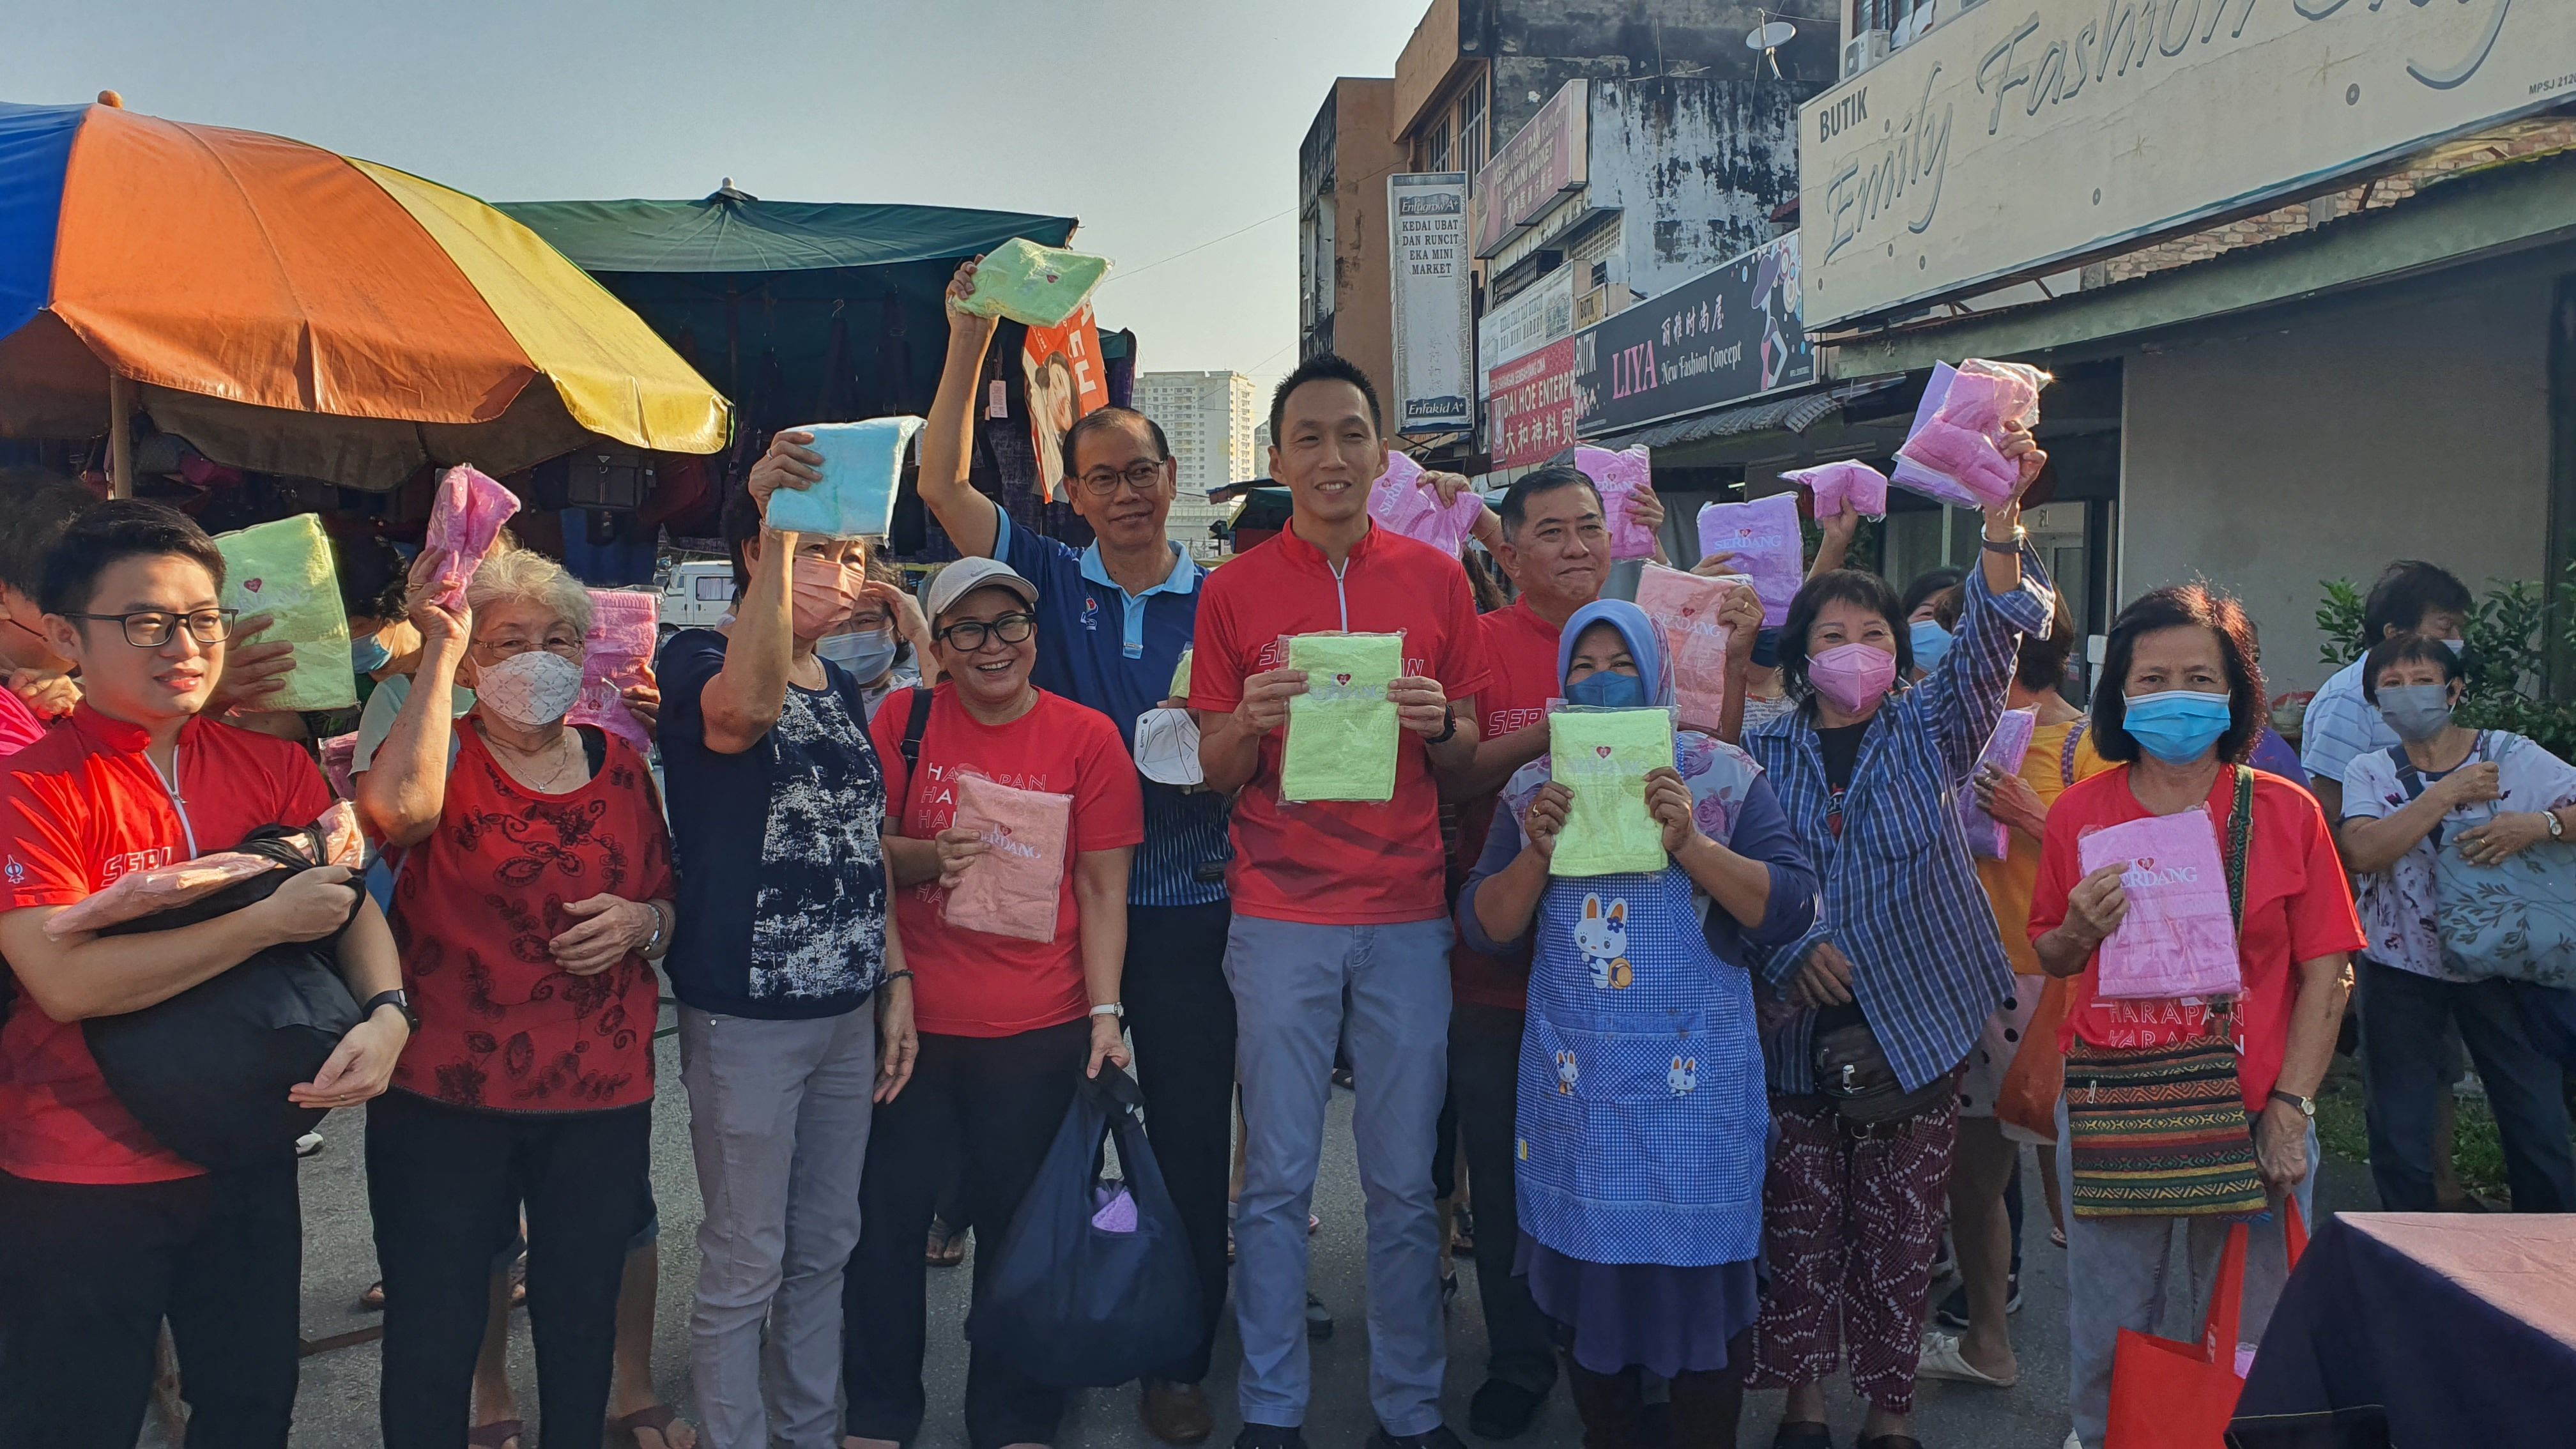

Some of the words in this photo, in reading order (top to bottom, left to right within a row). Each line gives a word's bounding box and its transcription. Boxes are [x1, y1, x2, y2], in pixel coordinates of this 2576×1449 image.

[2529, 79, 2555, 95] MPSJ
[1820, 86, 1868, 143] BUTIK
[1824, 61, 1952, 266] Emily
[1402, 220, 1431, 231] KEDAI
[1435, 219, 1458, 230] UBAT
[1402, 235, 1421, 246] DAN
[1425, 234, 1459, 245] RUNCIT
[1410, 250, 1429, 260] EKA
[1432, 249, 1453, 259] MINI
[1412, 263, 1452, 275] MARKET
[1580, 296, 1595, 319] BUTIK
[1576, 330, 1597, 378] BUTIK
[1612, 339, 1658, 399] LIYA
[1661, 360, 1678, 385] New
[1678, 351, 1707, 378] Fashion
[1709, 340, 1742, 373] Concept
[1409, 401, 1450, 415] Enfakid
[1503, 390, 1517, 418] DAI
[1519, 383, 1536, 414] HOE
[1714, 535, 1781, 550] SERDANG
[928, 762, 1047, 791] HAPAN
[981, 832, 1042, 859] ERDANG
[2119, 866, 2198, 887] ERDANG
